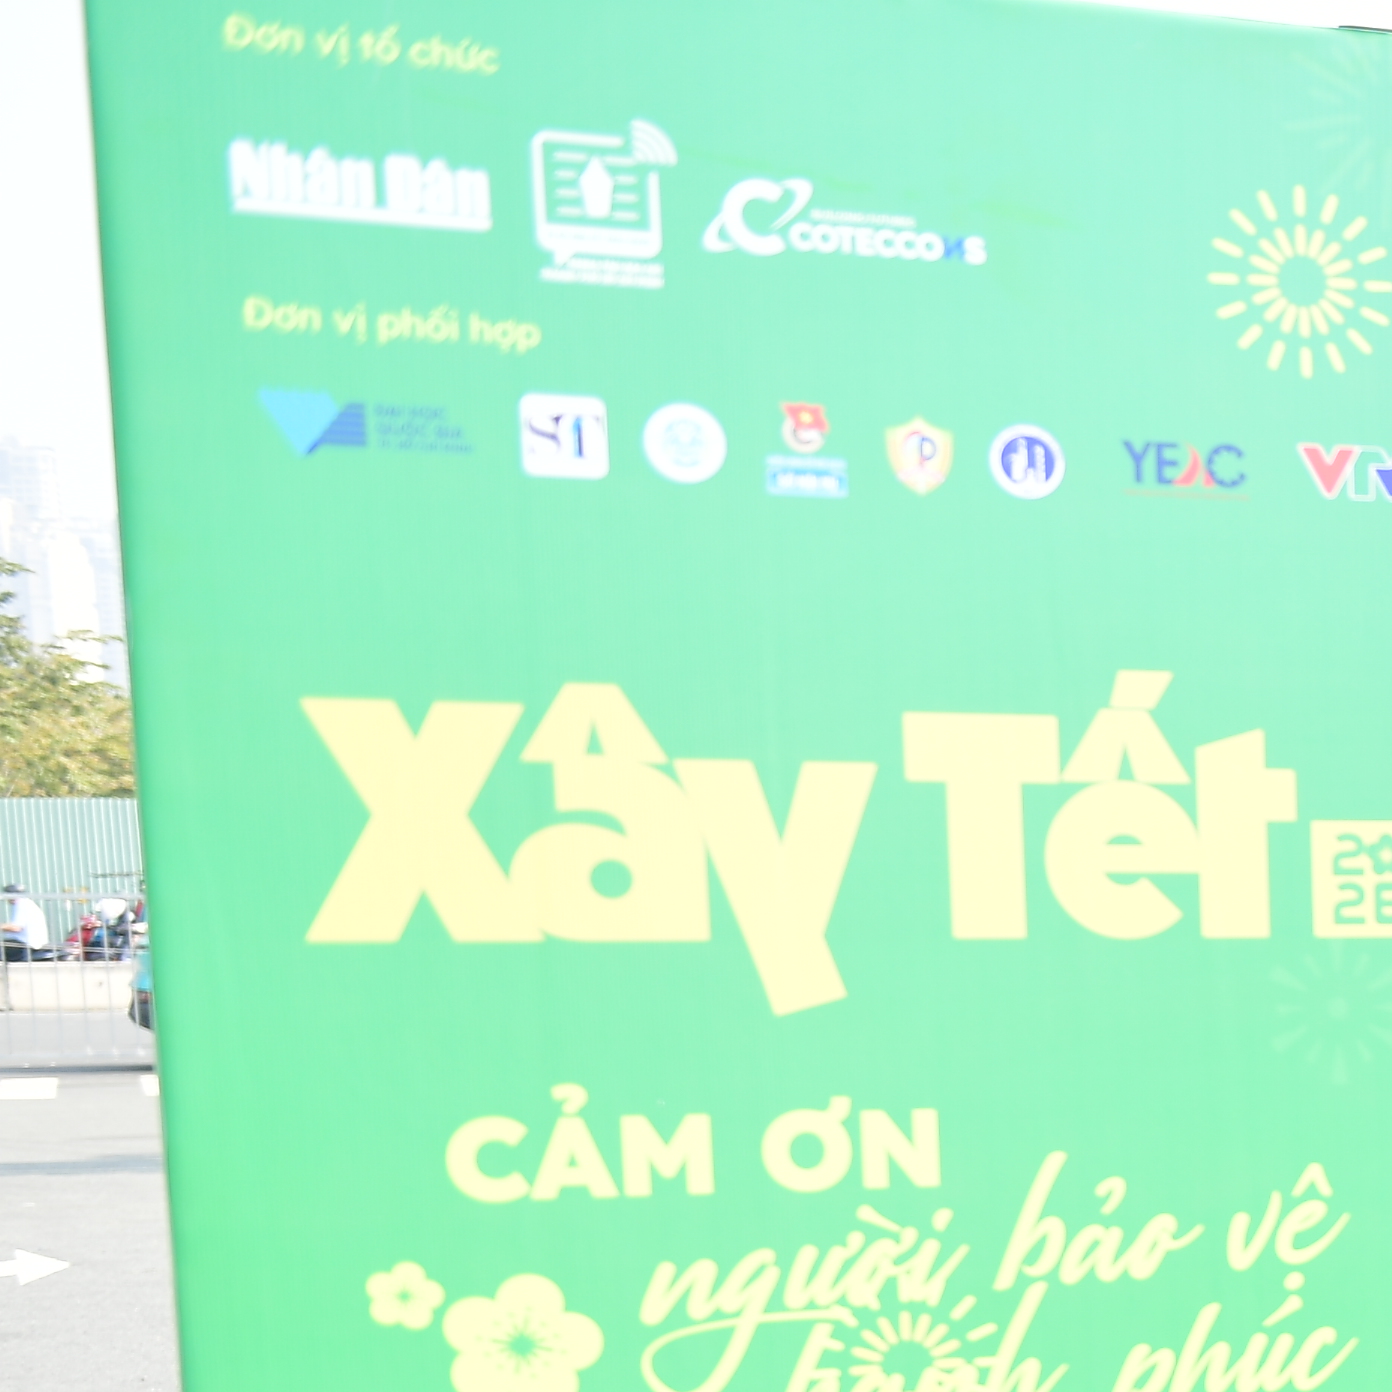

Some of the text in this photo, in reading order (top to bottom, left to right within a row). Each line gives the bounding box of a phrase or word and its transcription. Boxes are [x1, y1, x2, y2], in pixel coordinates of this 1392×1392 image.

[222, 12, 499, 76] Đơn vị tổ chức
[228, 137, 491, 220] Nhân Dân
[243, 295, 543, 355] Đơn vị phối hợp
[299, 669, 1299, 1017] Xây Tết
[444, 1082, 942, 1203] CẢM ƠN
[992, 1150, 1205, 1292] bảo
[1225, 1162, 1352, 1292] vệ
